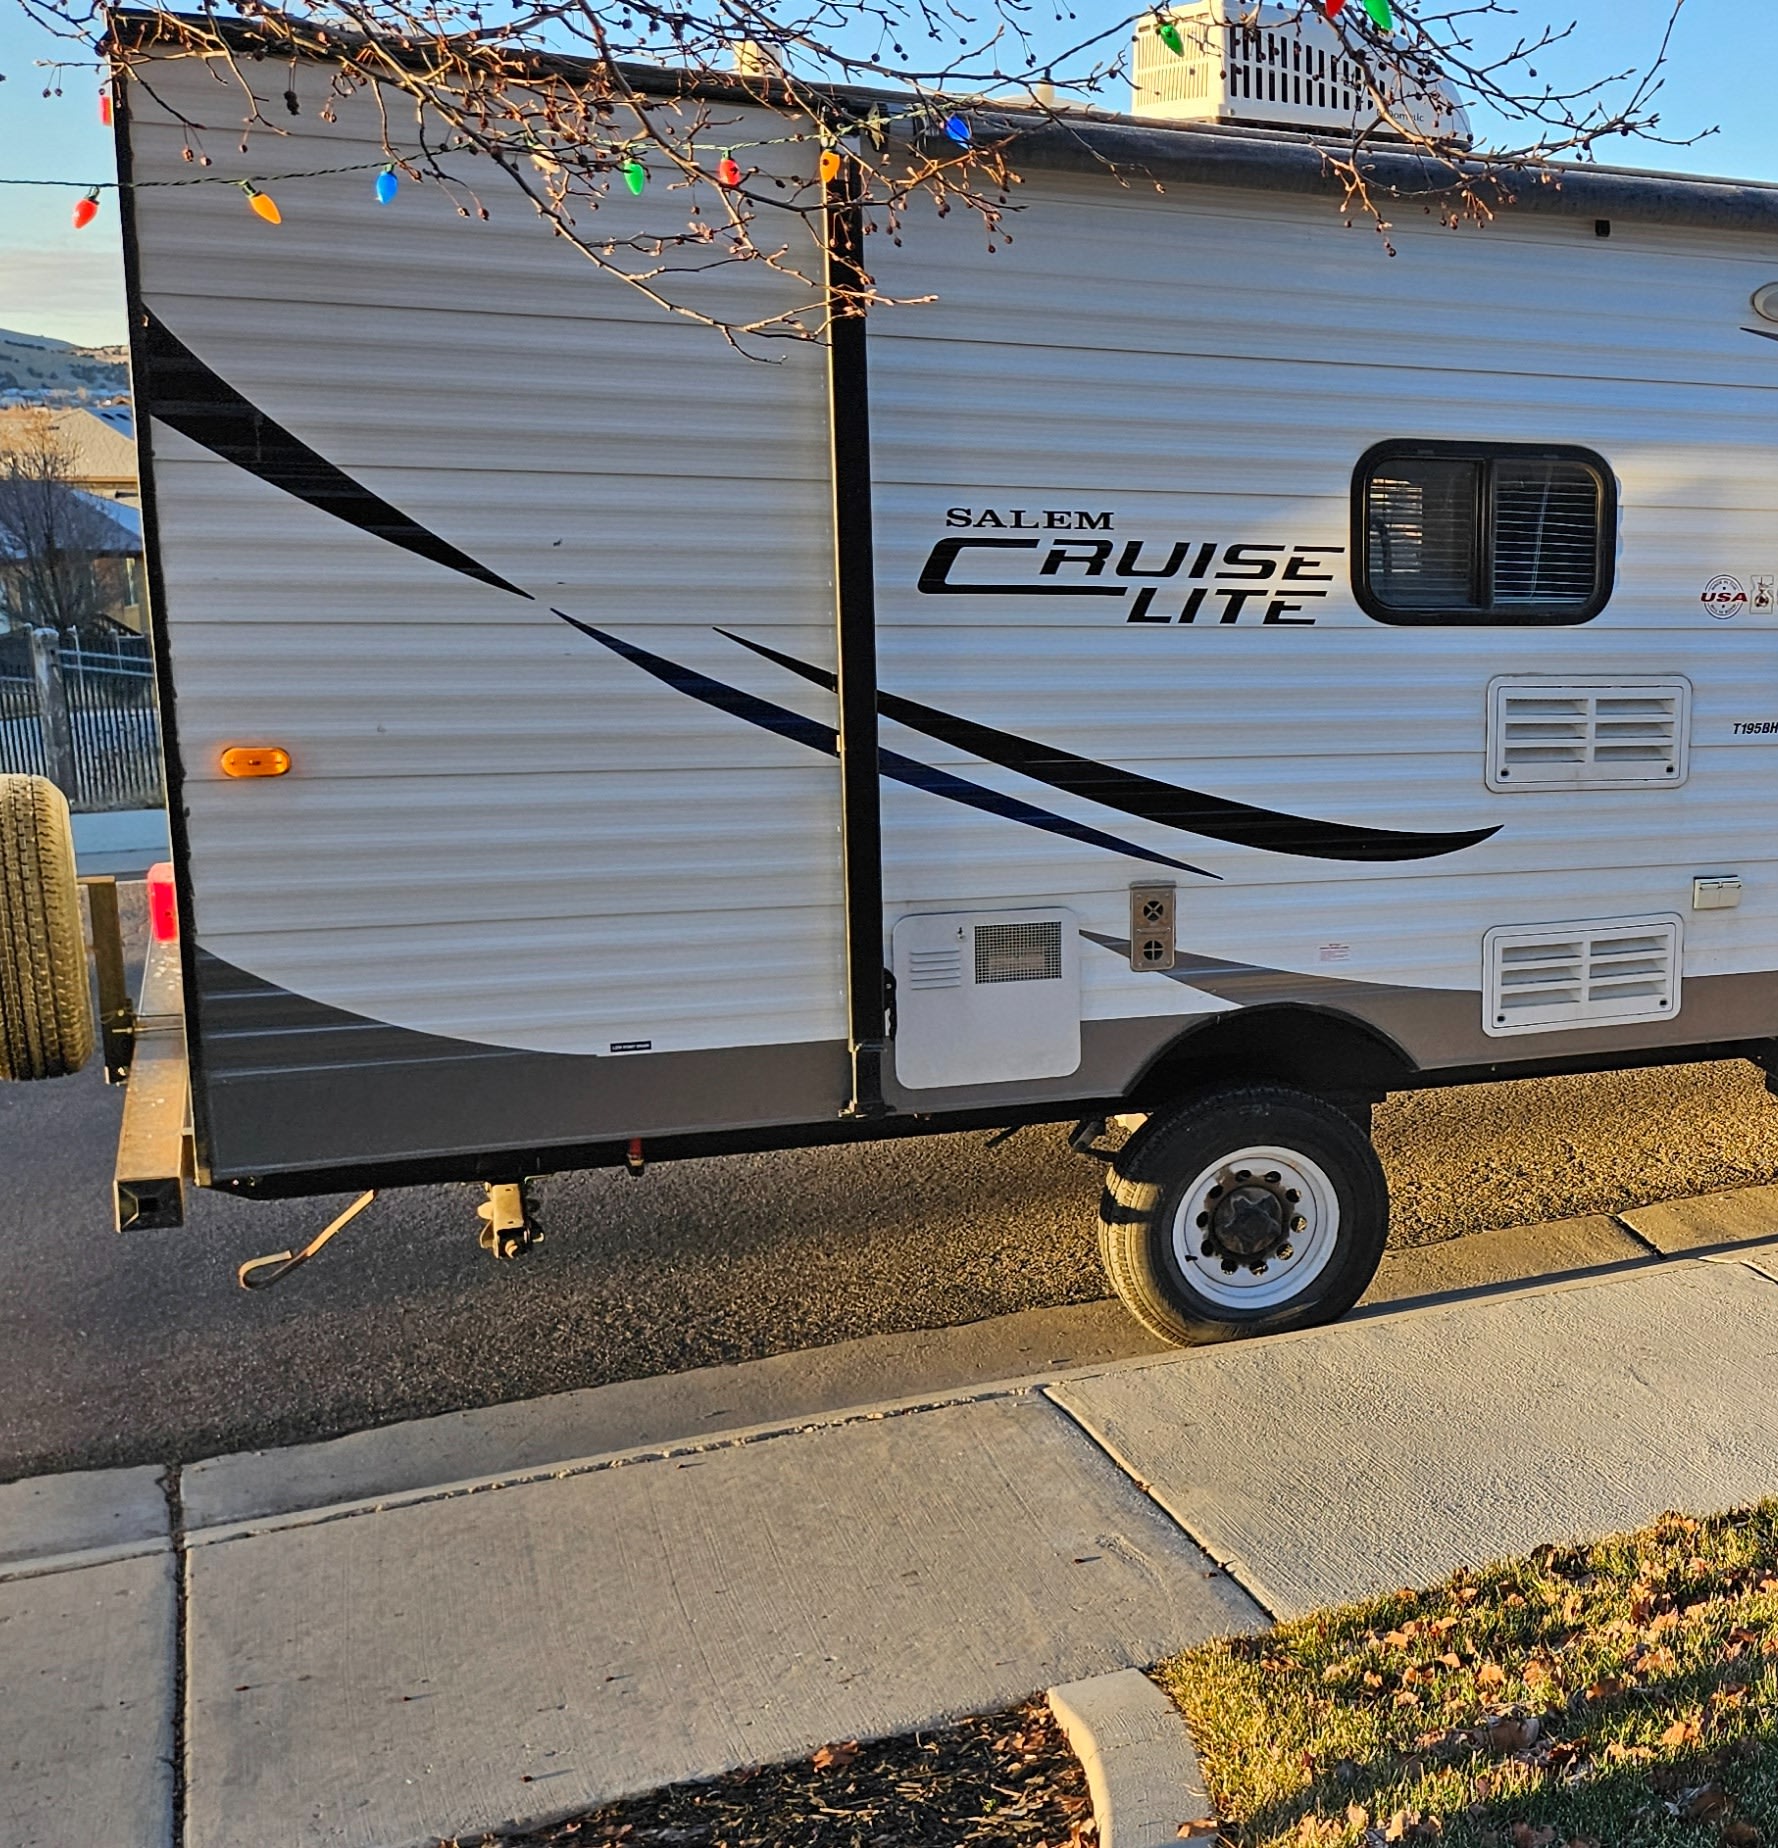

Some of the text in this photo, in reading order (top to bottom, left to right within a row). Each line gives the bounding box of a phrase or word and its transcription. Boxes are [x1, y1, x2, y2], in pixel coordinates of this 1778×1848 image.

[946, 507, 1115, 531] SALEM
[917, 536, 1346, 597] CRUISE
[1126, 587, 1329, 626] LITE
[1700, 592, 1749, 603] USA
